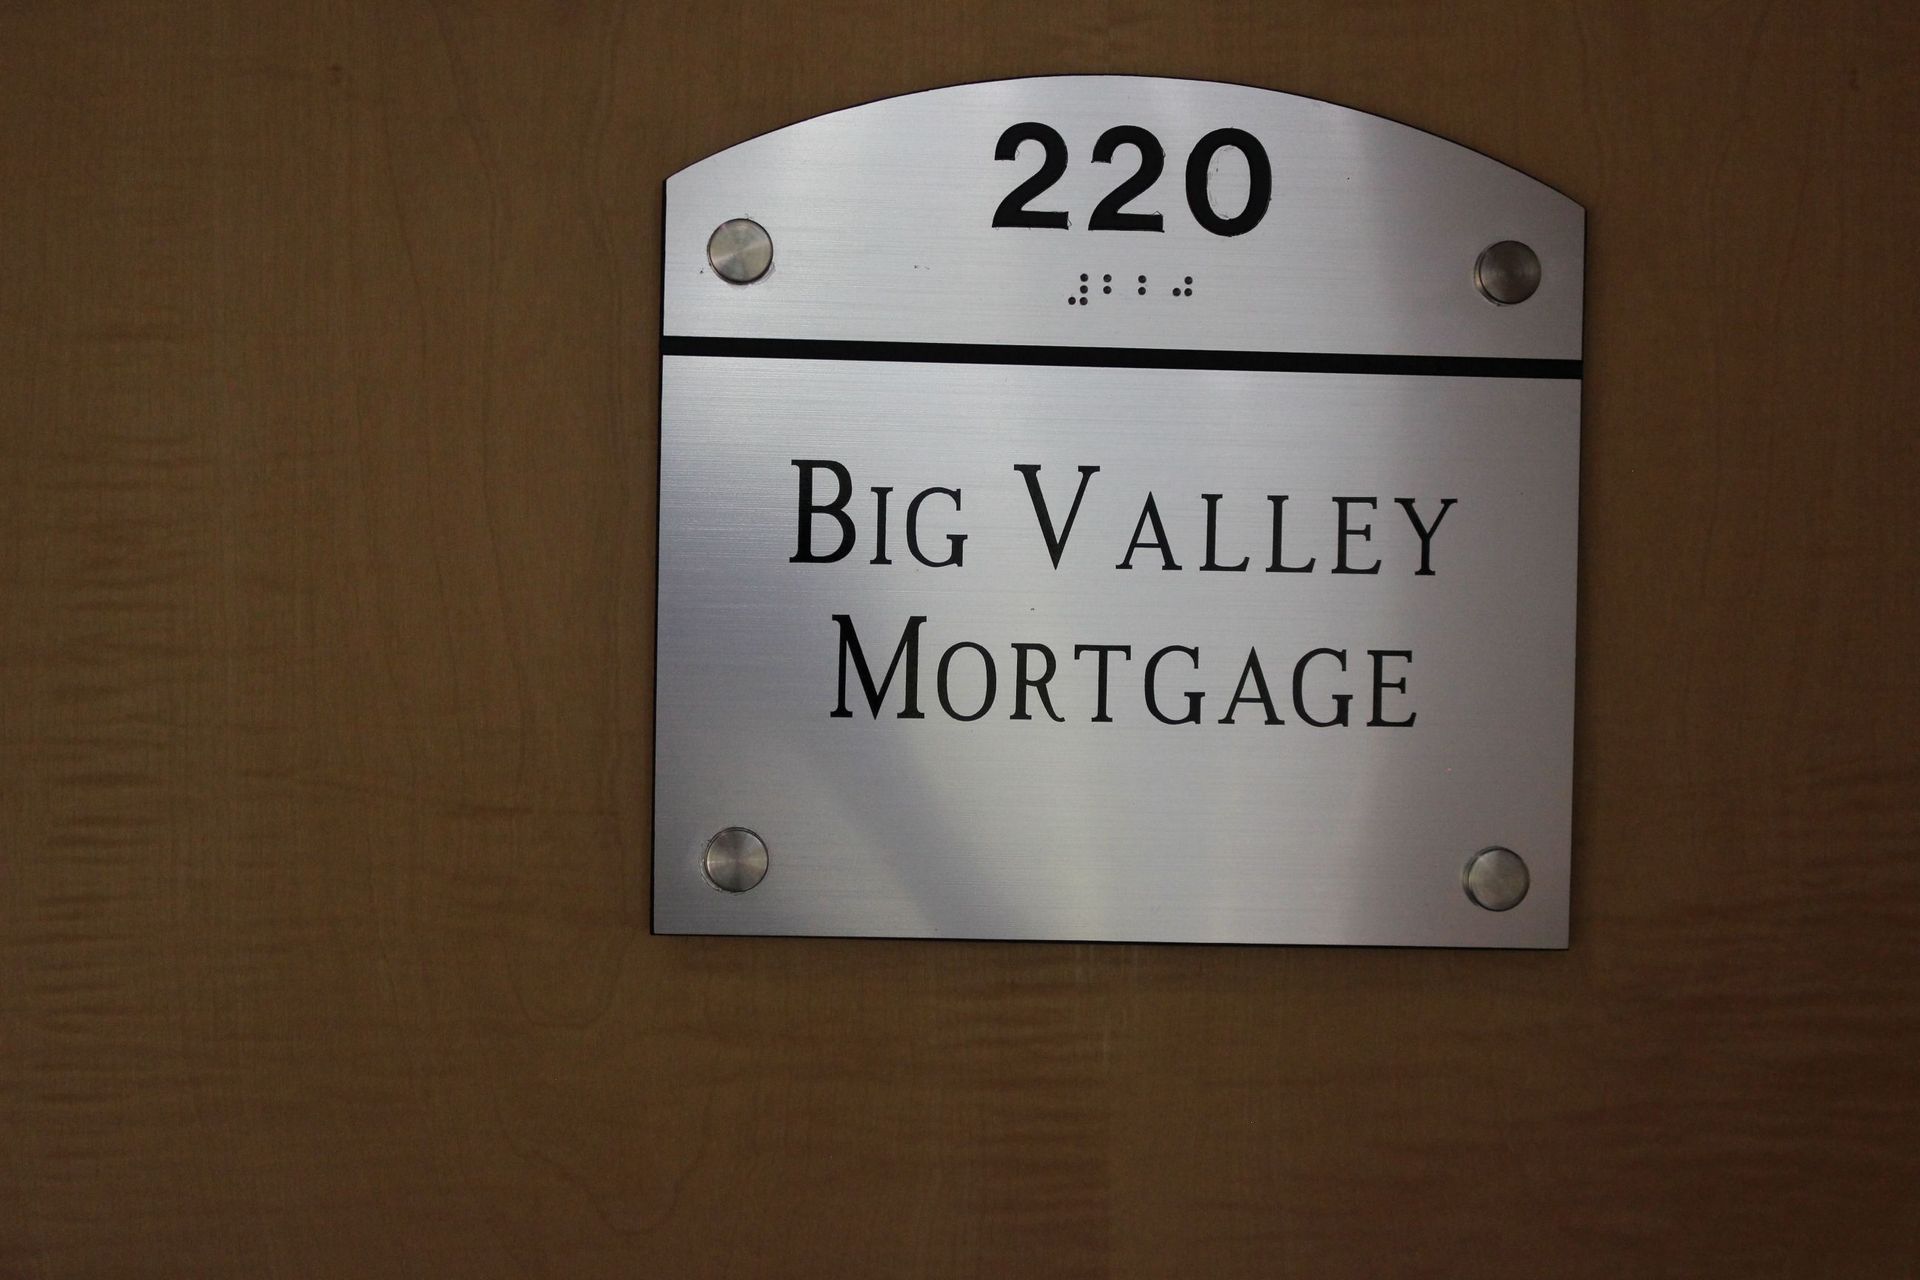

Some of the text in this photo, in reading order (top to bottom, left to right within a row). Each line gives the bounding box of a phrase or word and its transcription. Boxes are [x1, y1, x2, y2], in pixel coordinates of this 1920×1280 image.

[992, 122, 1272, 238] 220
[789, 460, 1459, 575] BIG VALLEY
[830, 615, 1417, 727] MORTGAGE
